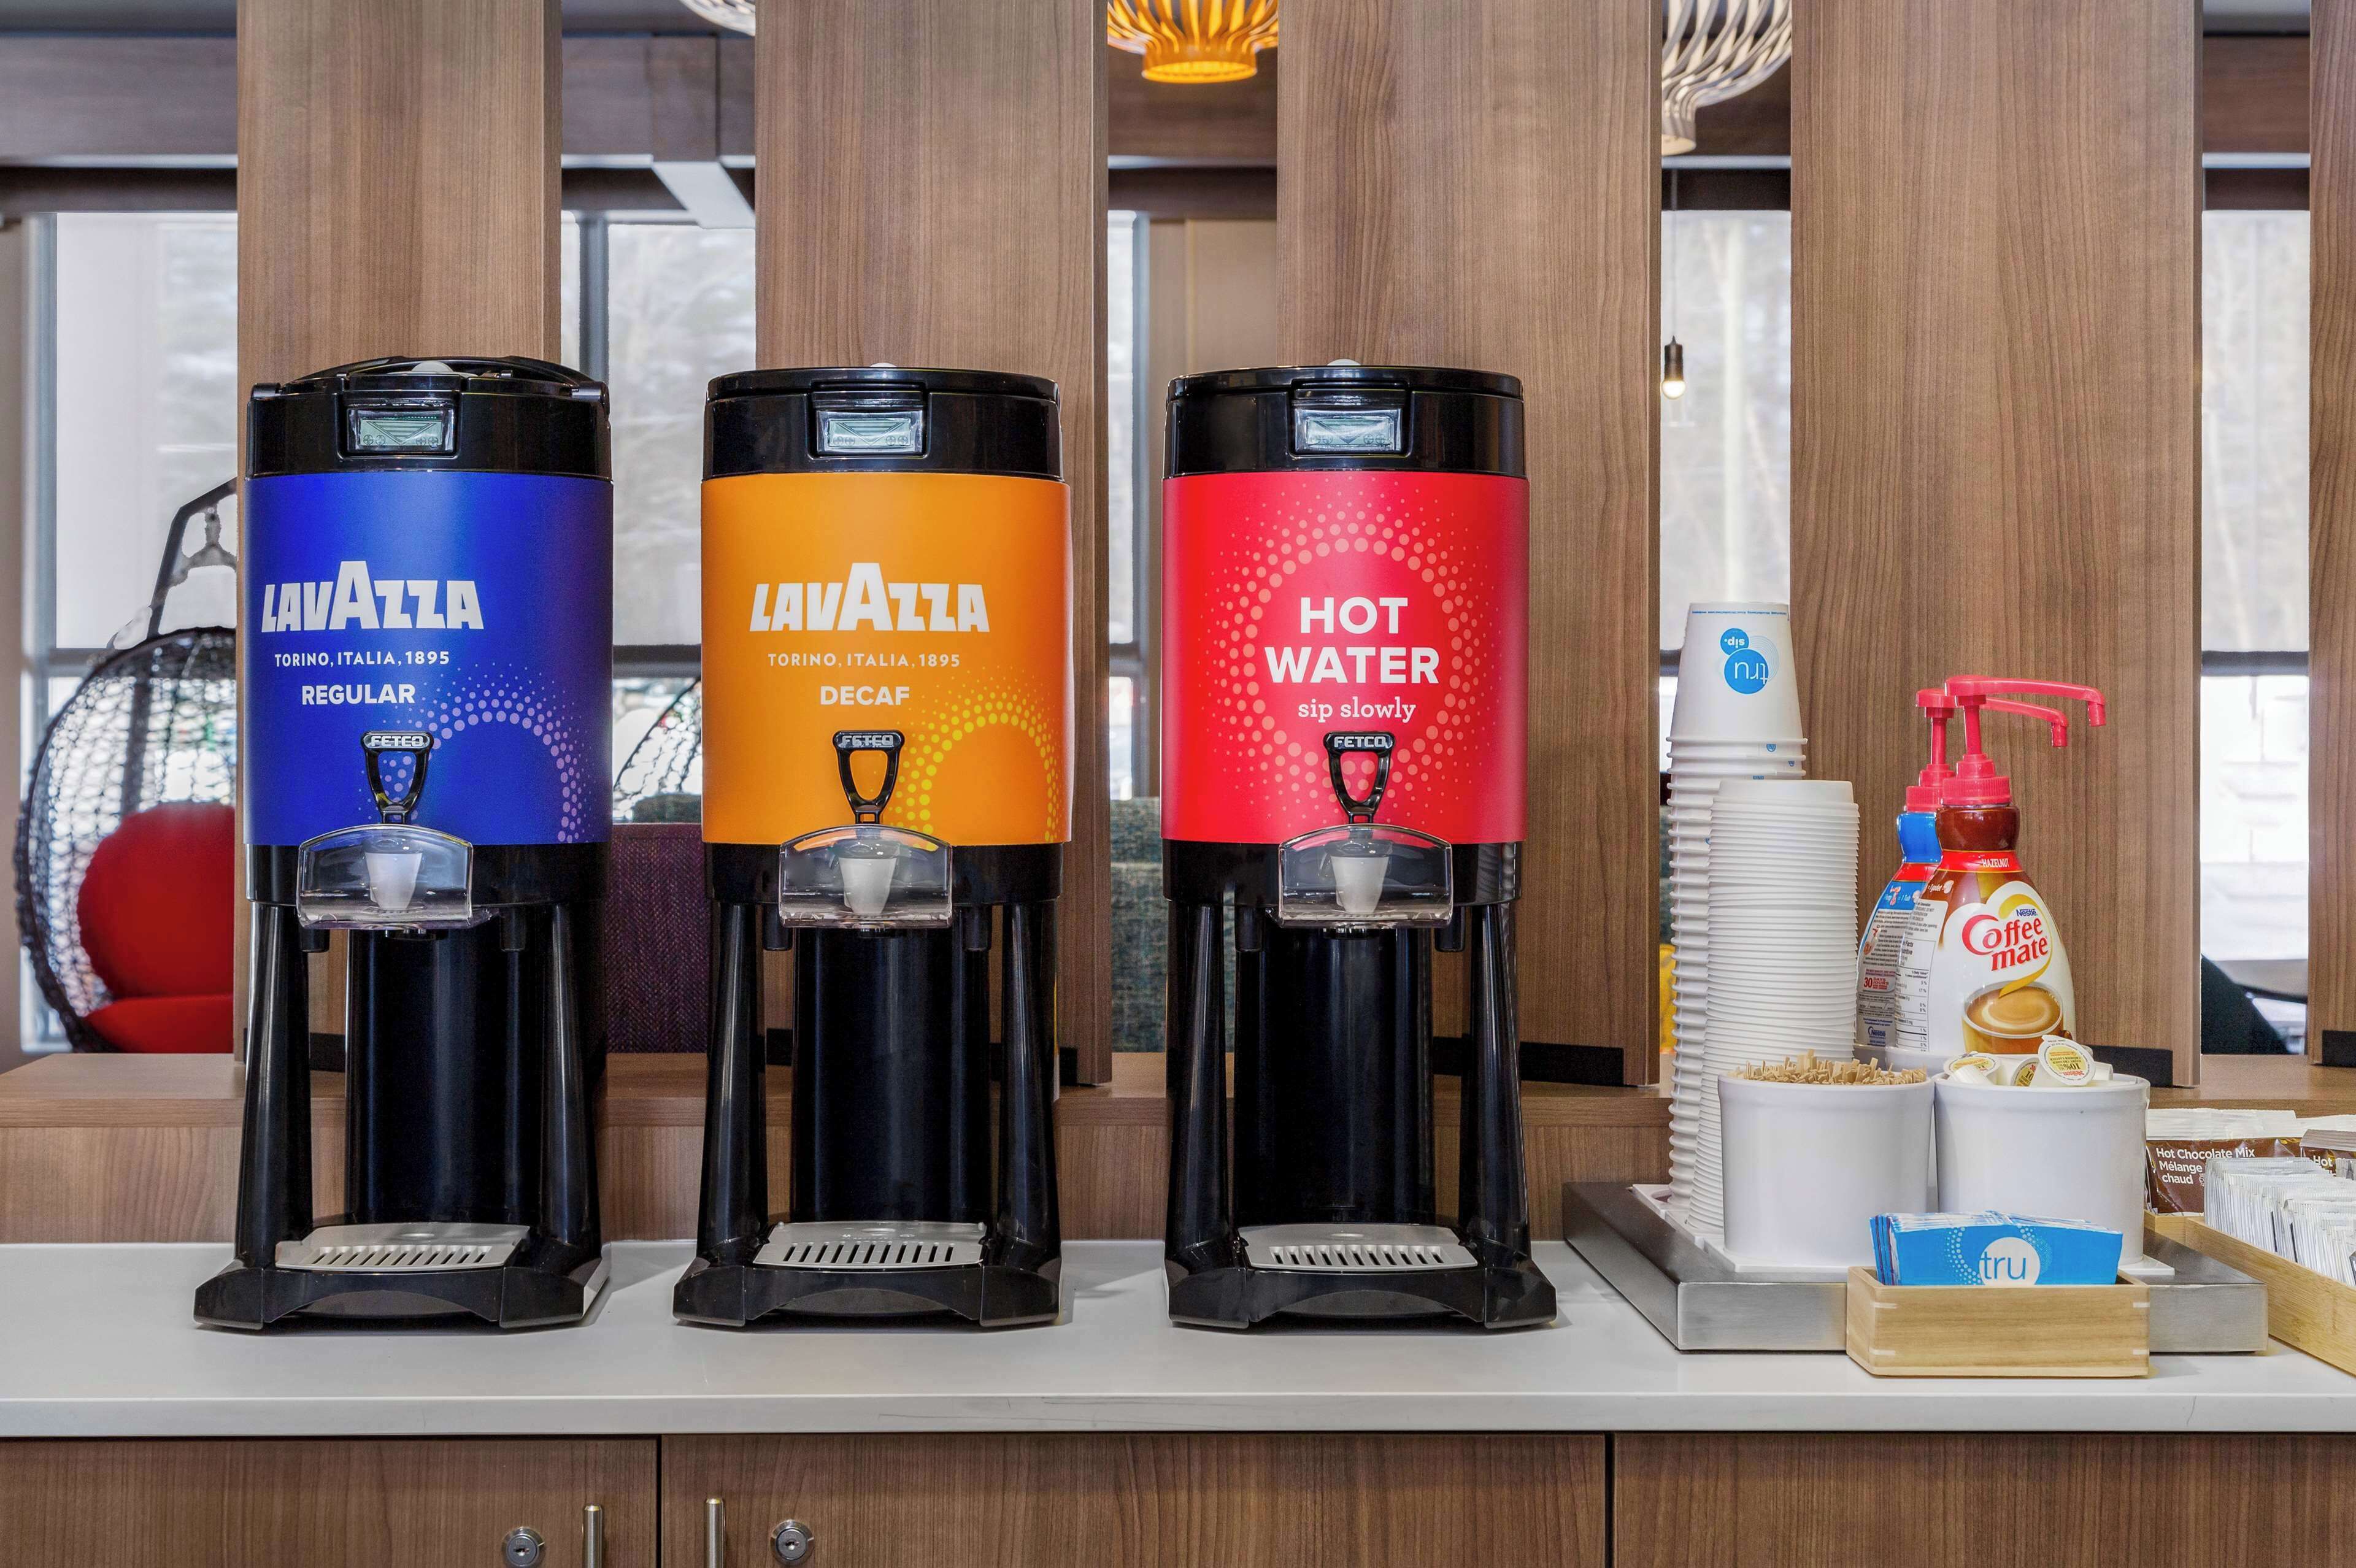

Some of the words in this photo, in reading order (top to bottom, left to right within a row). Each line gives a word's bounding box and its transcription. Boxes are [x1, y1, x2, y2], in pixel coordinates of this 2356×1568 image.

[261, 561, 483, 632] LAVAZZA
[750, 563, 990, 632] LAVAZZA
[1300, 597, 1408, 634] HOT
[274, 652, 334, 667] TORINO,
[337, 651, 402, 666] ITALIA,
[405, 651, 449, 664] 1895
[768, 653, 842, 668] TORINO,
[847, 653, 915, 669] ITALIA,
[919, 654, 960, 667] 1895
[1265, 647, 1439, 683] WATER
[1734, 661, 1768, 685] tru
[302, 684, 415, 705] REGULAR
[820, 686, 909, 705] DECAF
[1298, 698, 1333, 723] sip
[1340, 696, 1416, 723] slowly
[371, 736, 423, 747] FETCO
[842, 735, 893, 746] FETCO
[1334, 736, 1386, 747] FETCO
[1982, 858, 2009, 867] HAZELNUT
[1961, 915, 2043, 955] Coffee
[1992, 937, 2048, 971] mate
[2156, 1148, 2176, 1159] Hot
[2178, 1148, 2233, 1159] Chocolate
[2235, 1147, 2255, 1158] Mix
[2313, 1155, 2333, 1167] Hot
[2160, 1161, 2203, 1174] Mélange
[2162, 1173, 2193, 1185] chaud
